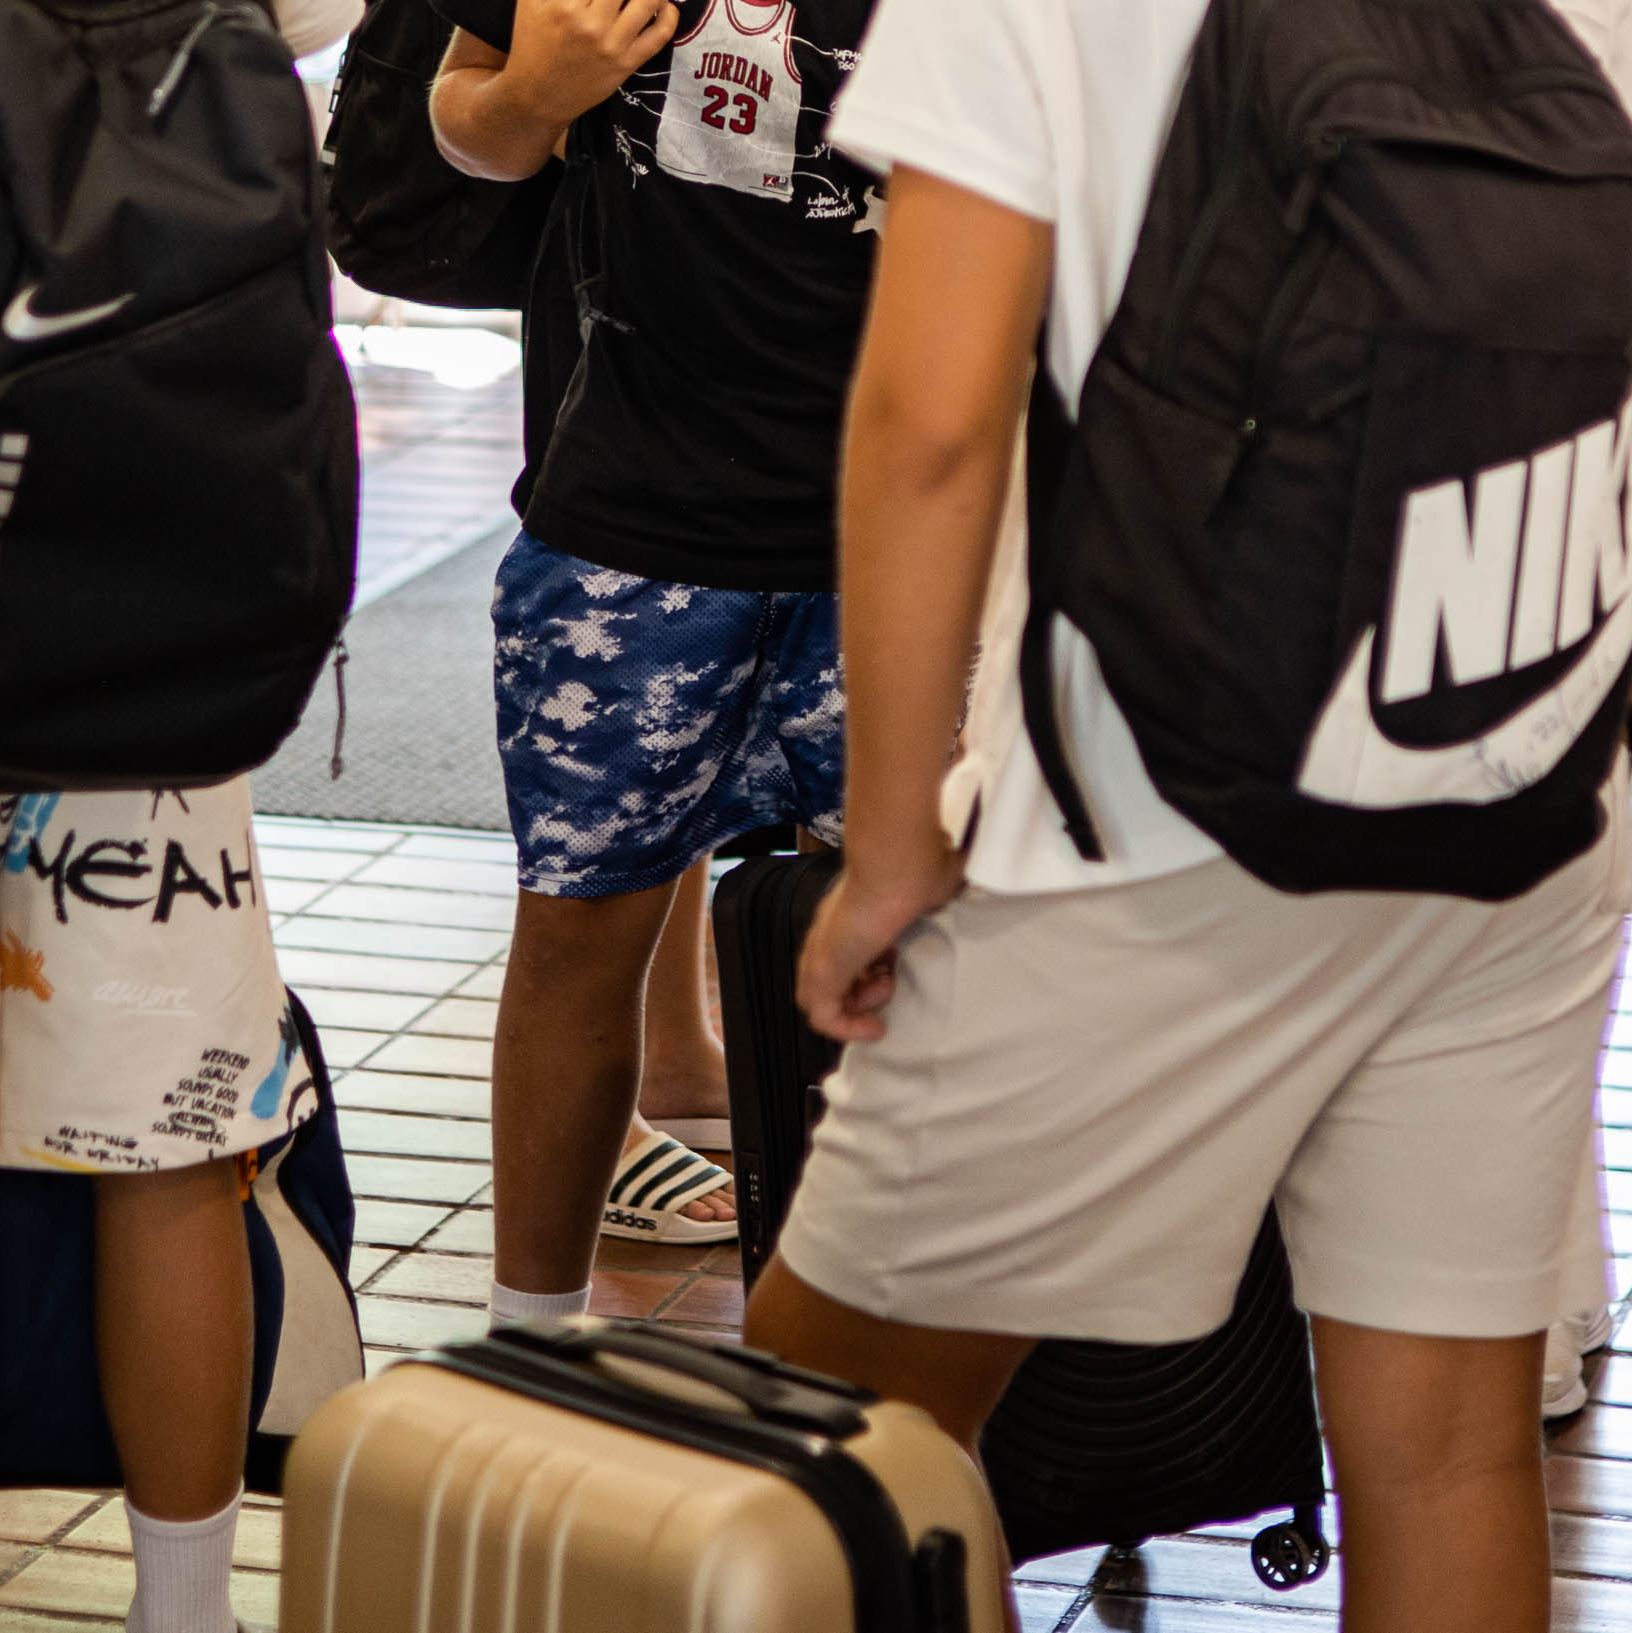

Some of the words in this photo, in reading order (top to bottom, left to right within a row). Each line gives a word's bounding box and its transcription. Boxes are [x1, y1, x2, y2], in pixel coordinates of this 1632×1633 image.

[694, 52, 773, 103] JORDAN
[700, 84, 758, 135] 23
[27, 829, 257, 924] YEAH
